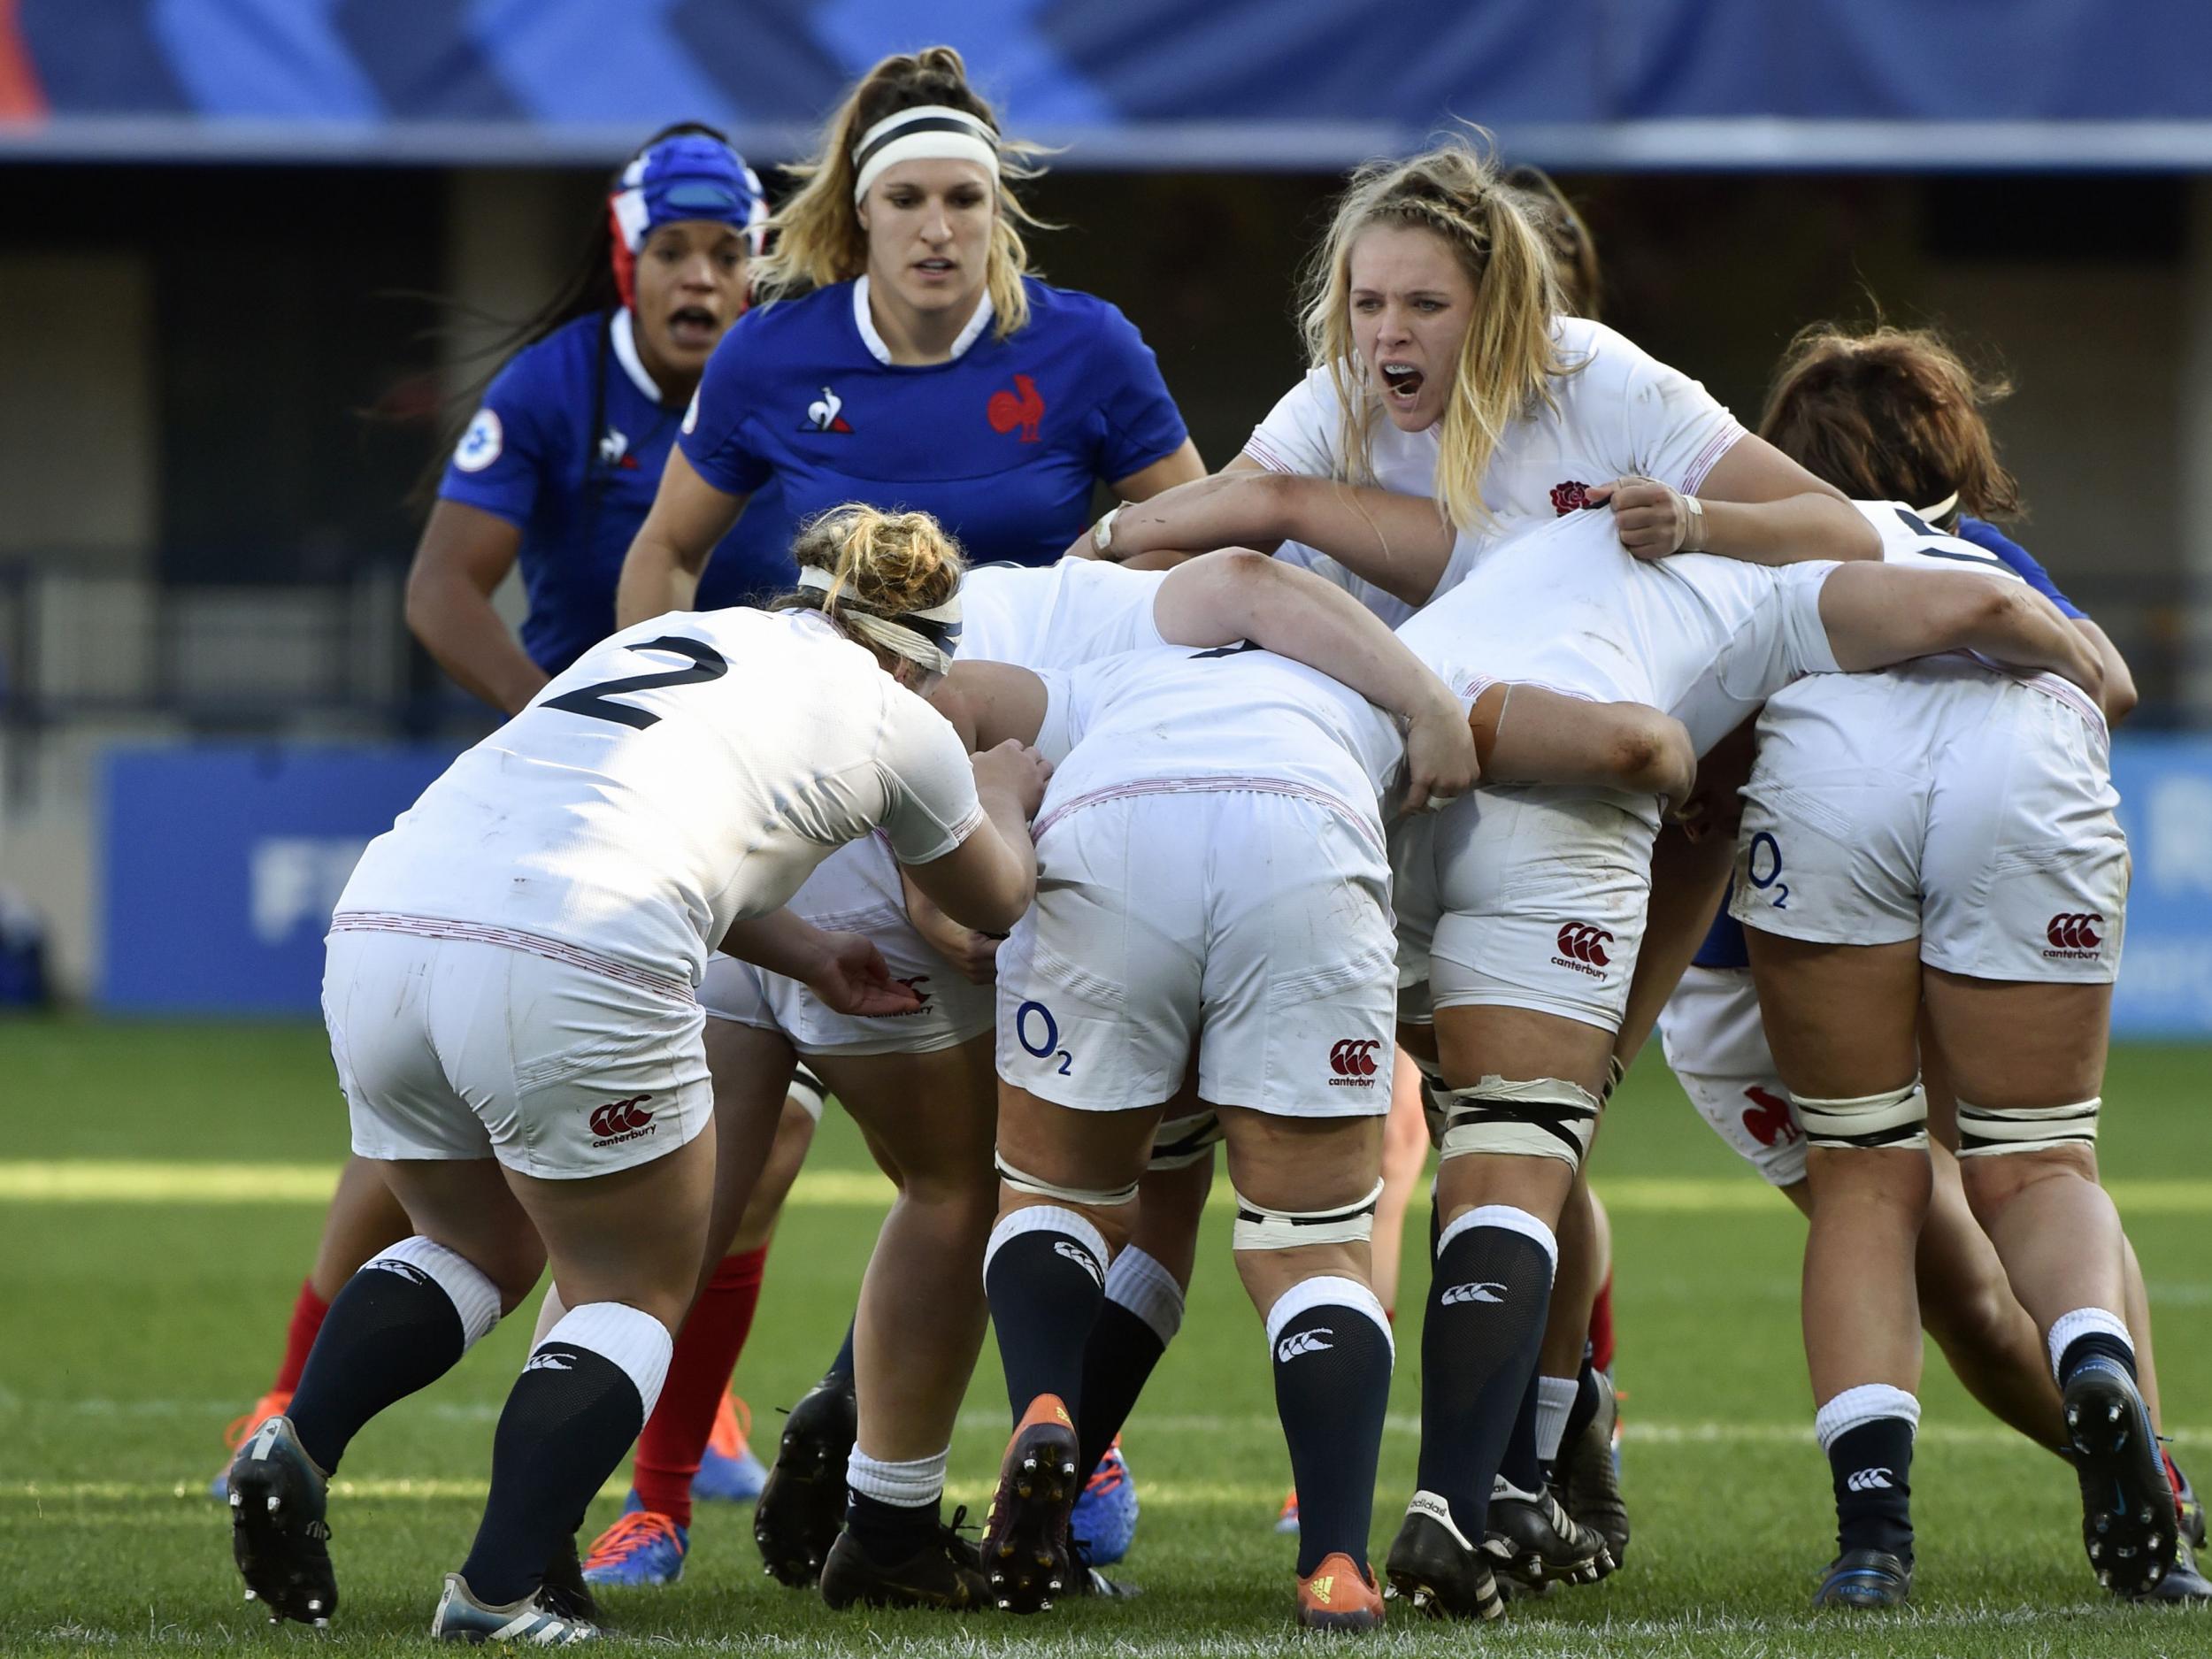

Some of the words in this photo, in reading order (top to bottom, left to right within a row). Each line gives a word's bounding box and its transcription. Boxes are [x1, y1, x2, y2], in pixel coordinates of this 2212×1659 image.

[537, 635, 728, 731] 2
[2043, 949, 2101, 963] canterbury
[1550, 956, 1609, 981] canterbury
[1328, 1077, 1376, 1089] canterbury
[593, 1125, 657, 1148] canterbury
